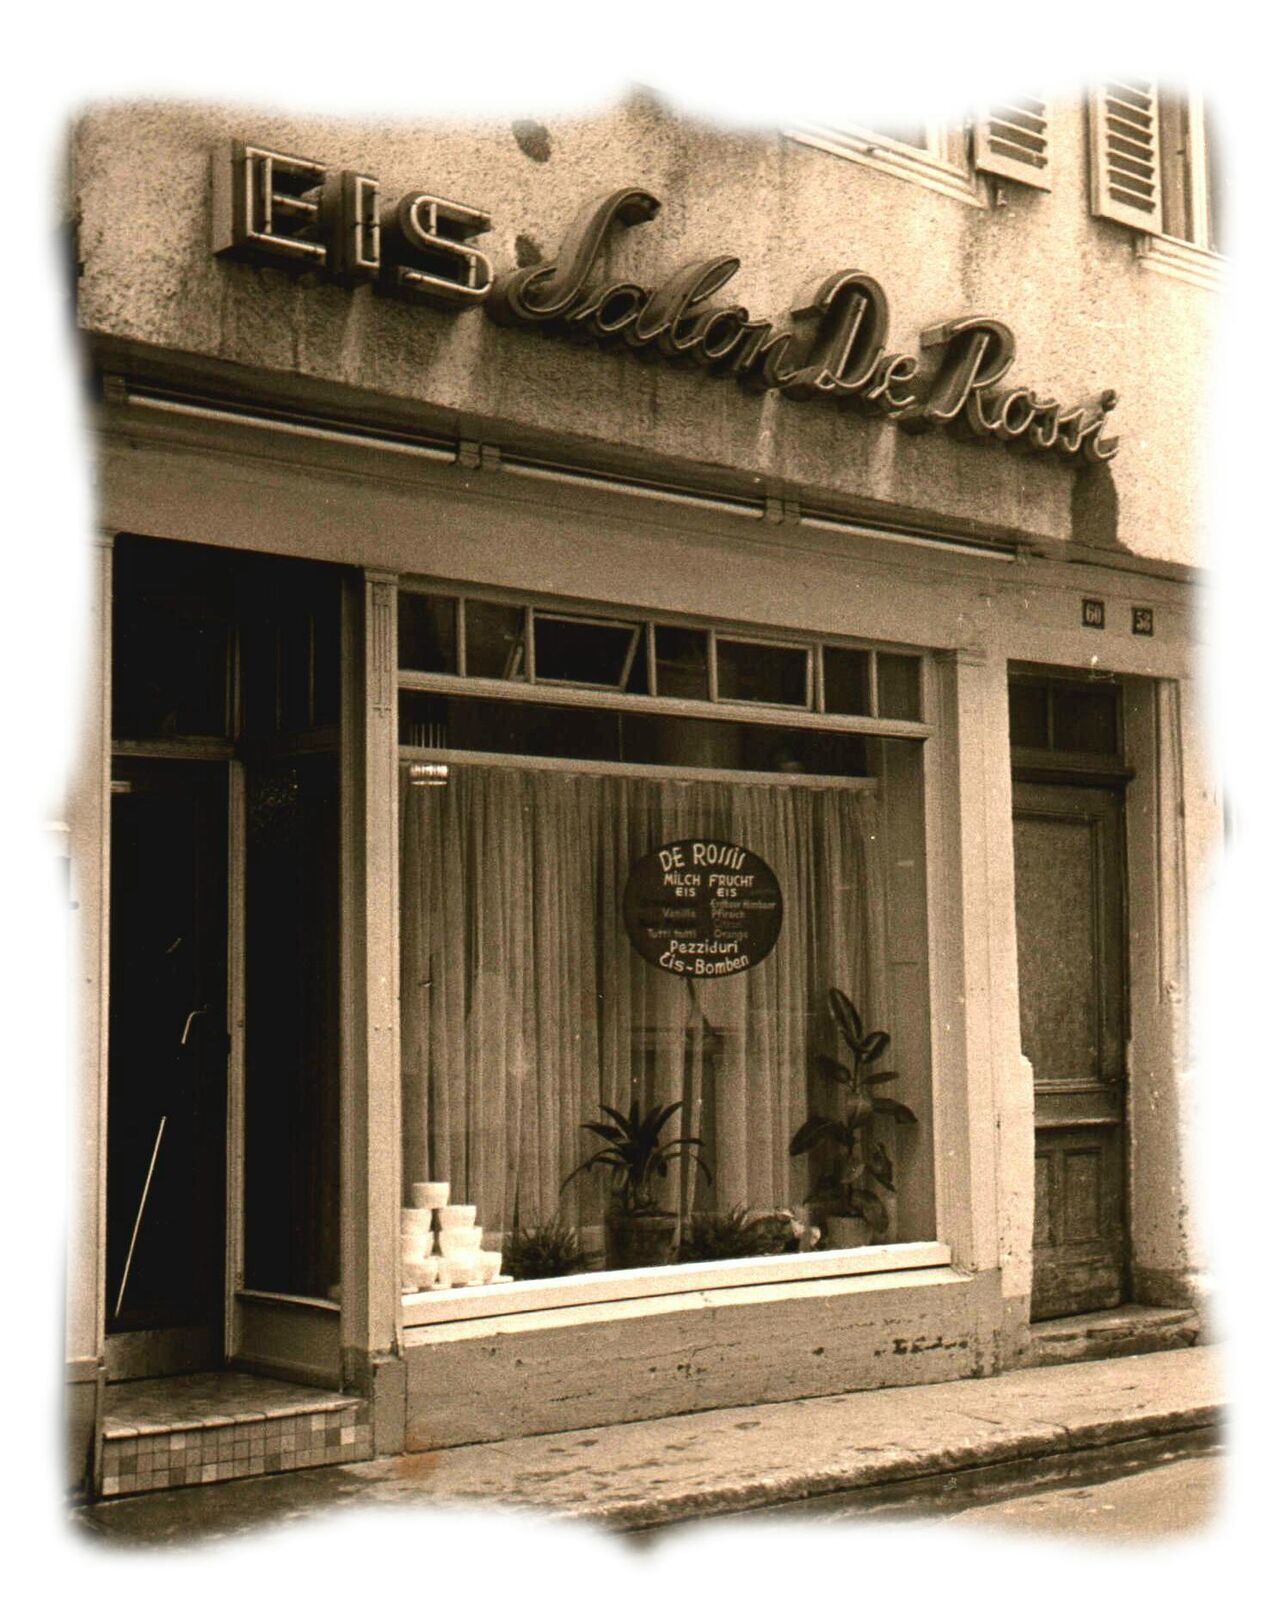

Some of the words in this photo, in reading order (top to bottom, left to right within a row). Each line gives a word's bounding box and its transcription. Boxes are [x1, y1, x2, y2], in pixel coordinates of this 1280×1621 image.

[222, 140, 493, 304] EIS
[507, 186, 796, 388] Salon
[794, 267, 918, 410] De
[920, 315, 1121, 461] Rossi
[1085, 603, 1102, 625] 60
[658, 847, 686, 872] DE
[708, 874, 754, 887] FRUCHT
[675, 887, 696, 897] EIS
[716, 887, 738, 897] EIS
[669, 939, 739, 954] Pezziduri
[659, 951, 750, 975] Eis-Bomben
